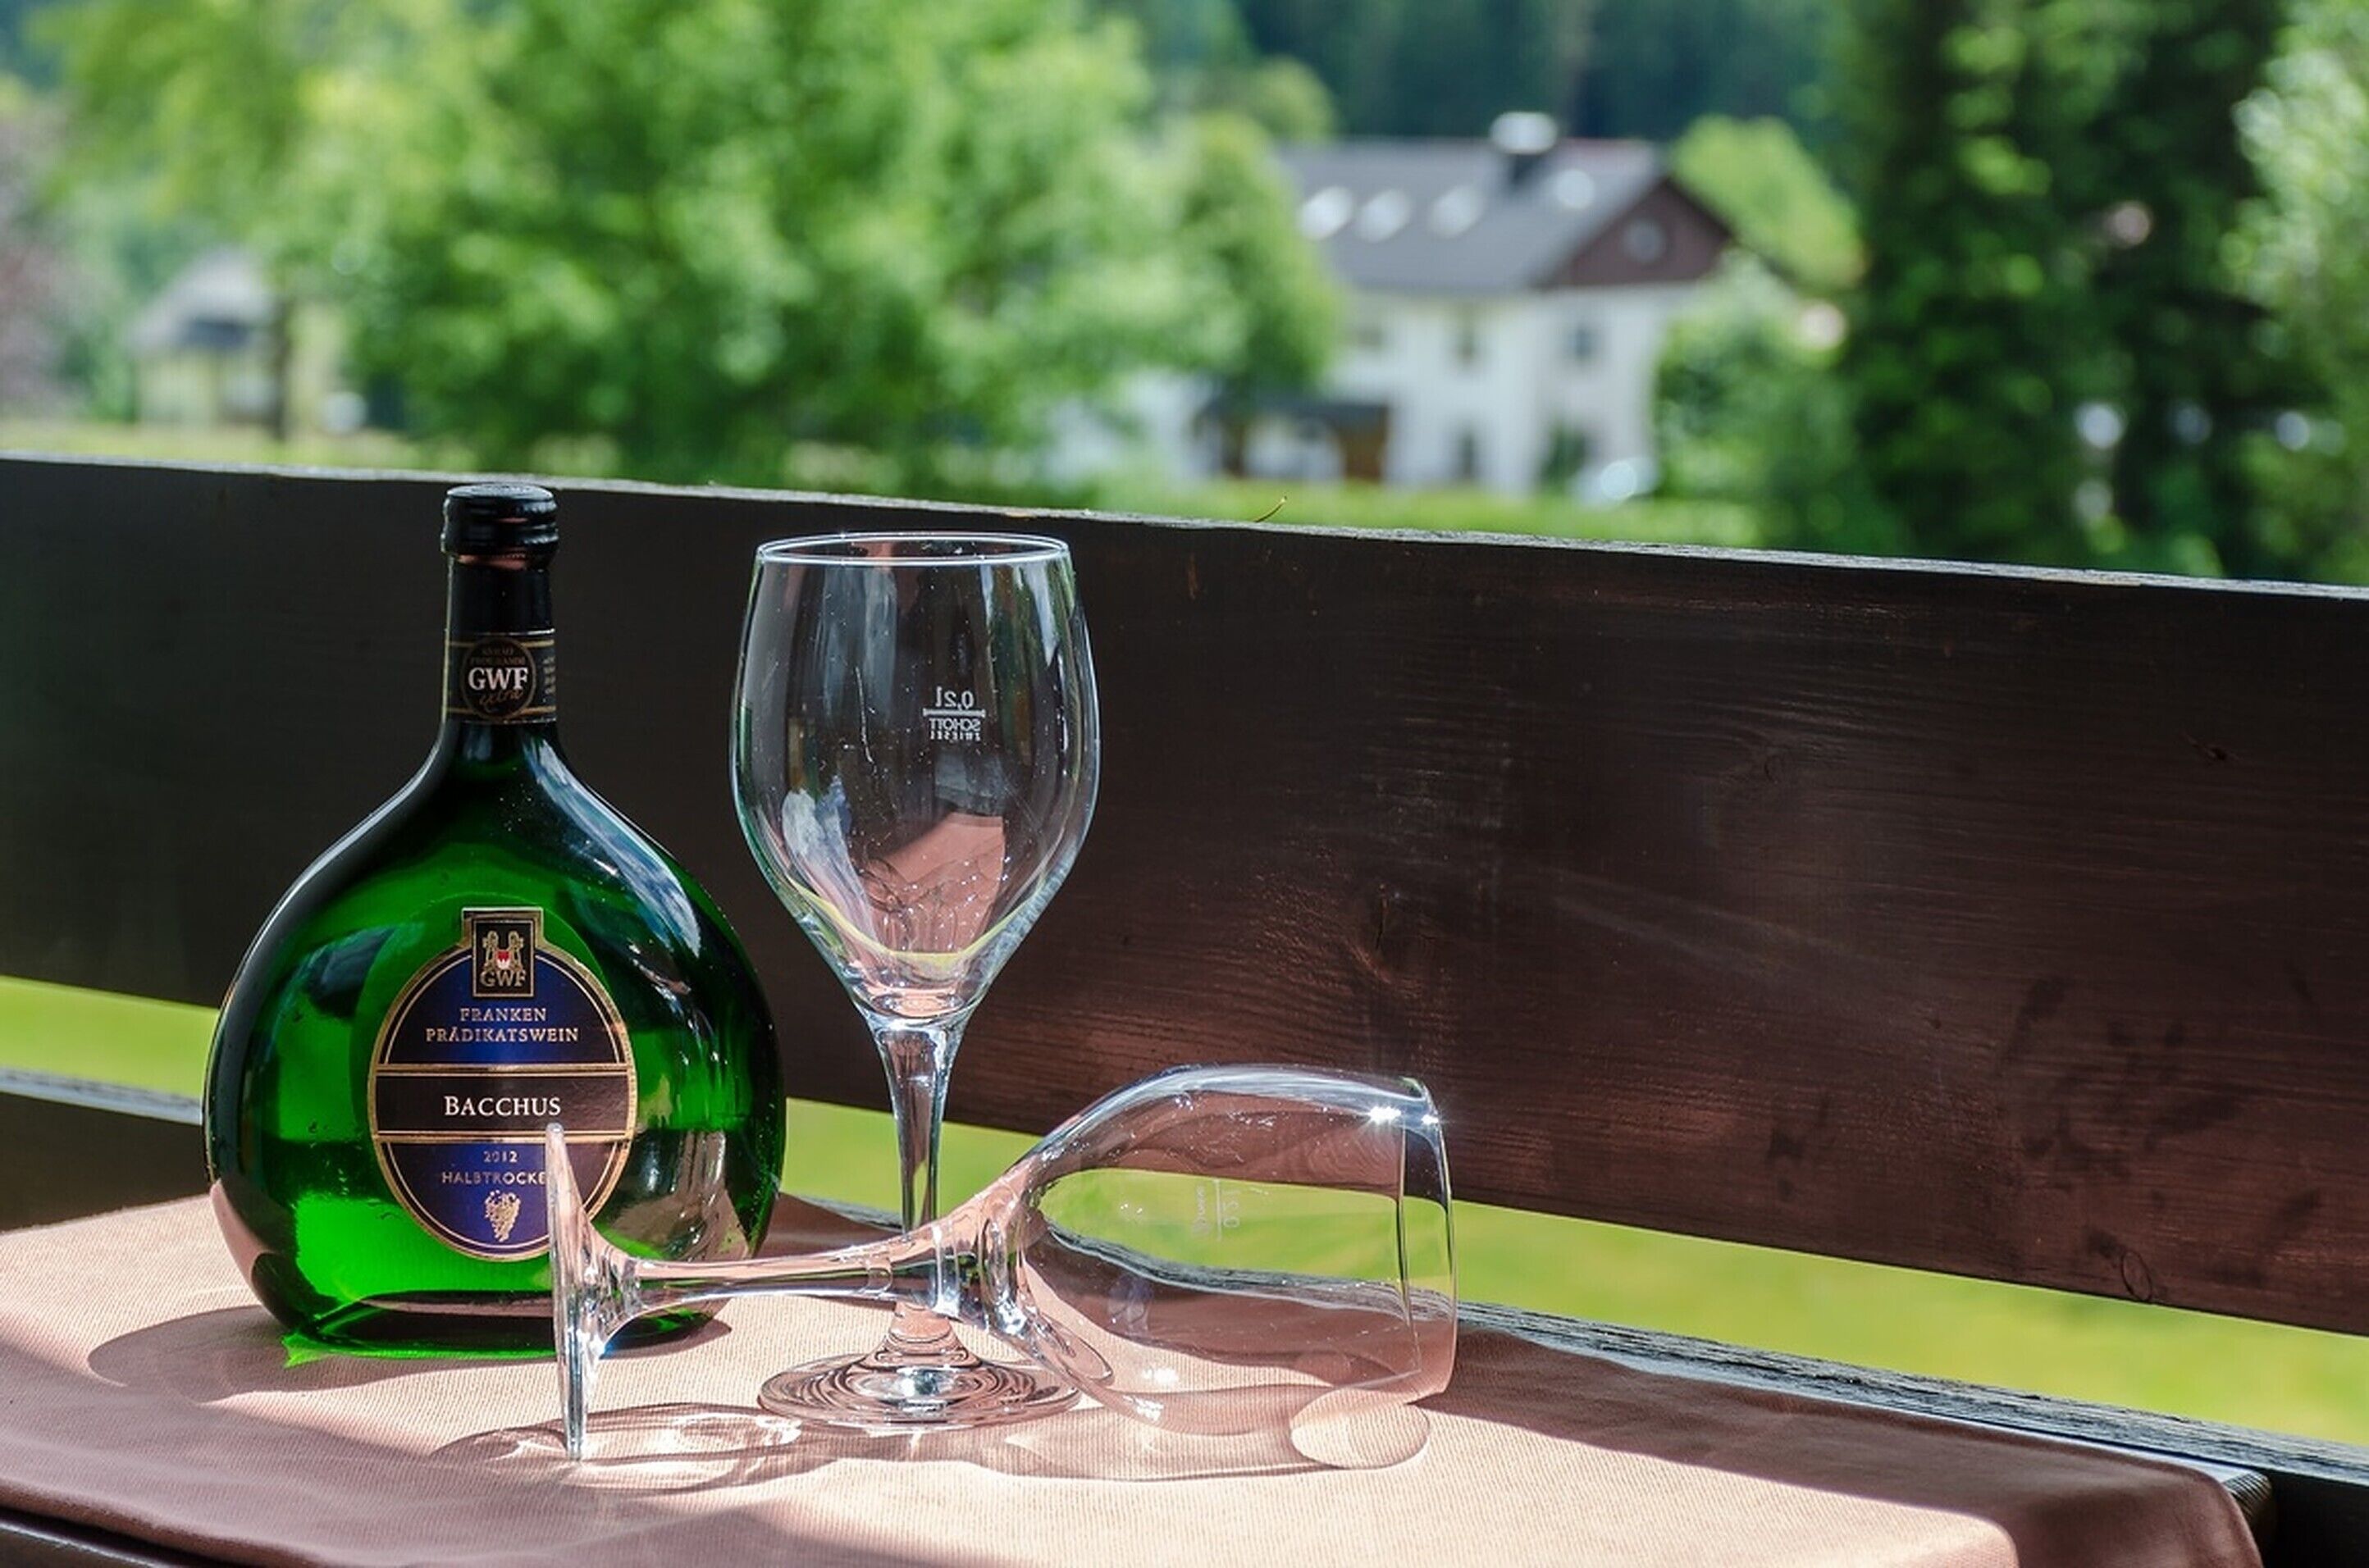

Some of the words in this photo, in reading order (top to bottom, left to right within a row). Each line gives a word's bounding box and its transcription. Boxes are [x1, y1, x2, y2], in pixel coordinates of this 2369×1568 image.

[468, 666, 529, 691] GWF
[479, 969, 527, 987] GWF
[459, 1007, 547, 1022] FRANKEN
[425, 1026, 579, 1042] PRÄDIKATSWEIN
[483, 1150, 518, 1163] 2012
[441, 1170, 546, 1185] HALBTROCKE
